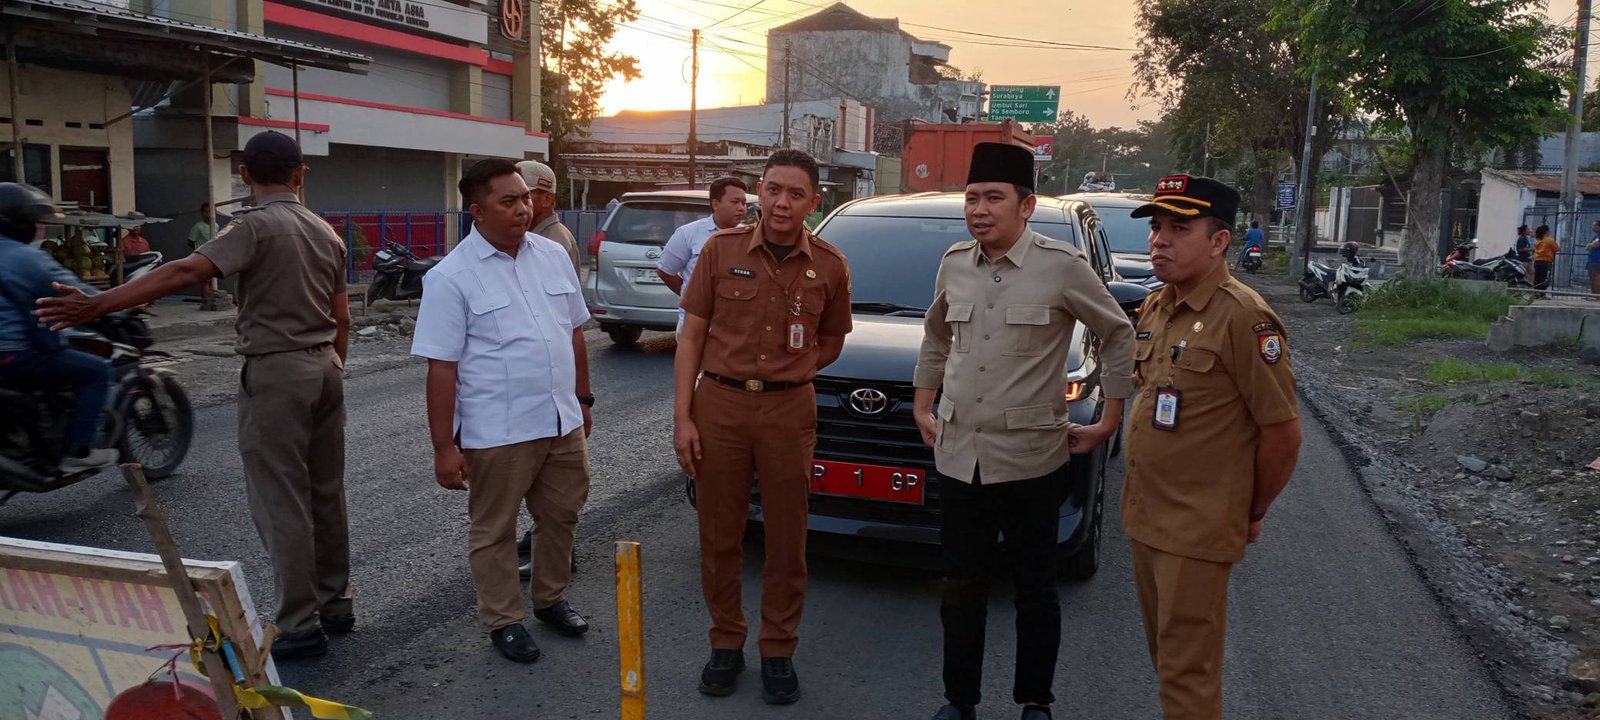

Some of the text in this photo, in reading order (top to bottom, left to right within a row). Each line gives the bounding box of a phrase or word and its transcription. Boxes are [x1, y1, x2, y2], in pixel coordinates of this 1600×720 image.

[405, 3, 425, 18] ASIA
[853, 468, 862, 488] 1
[891, 472, 918, 492] GP
